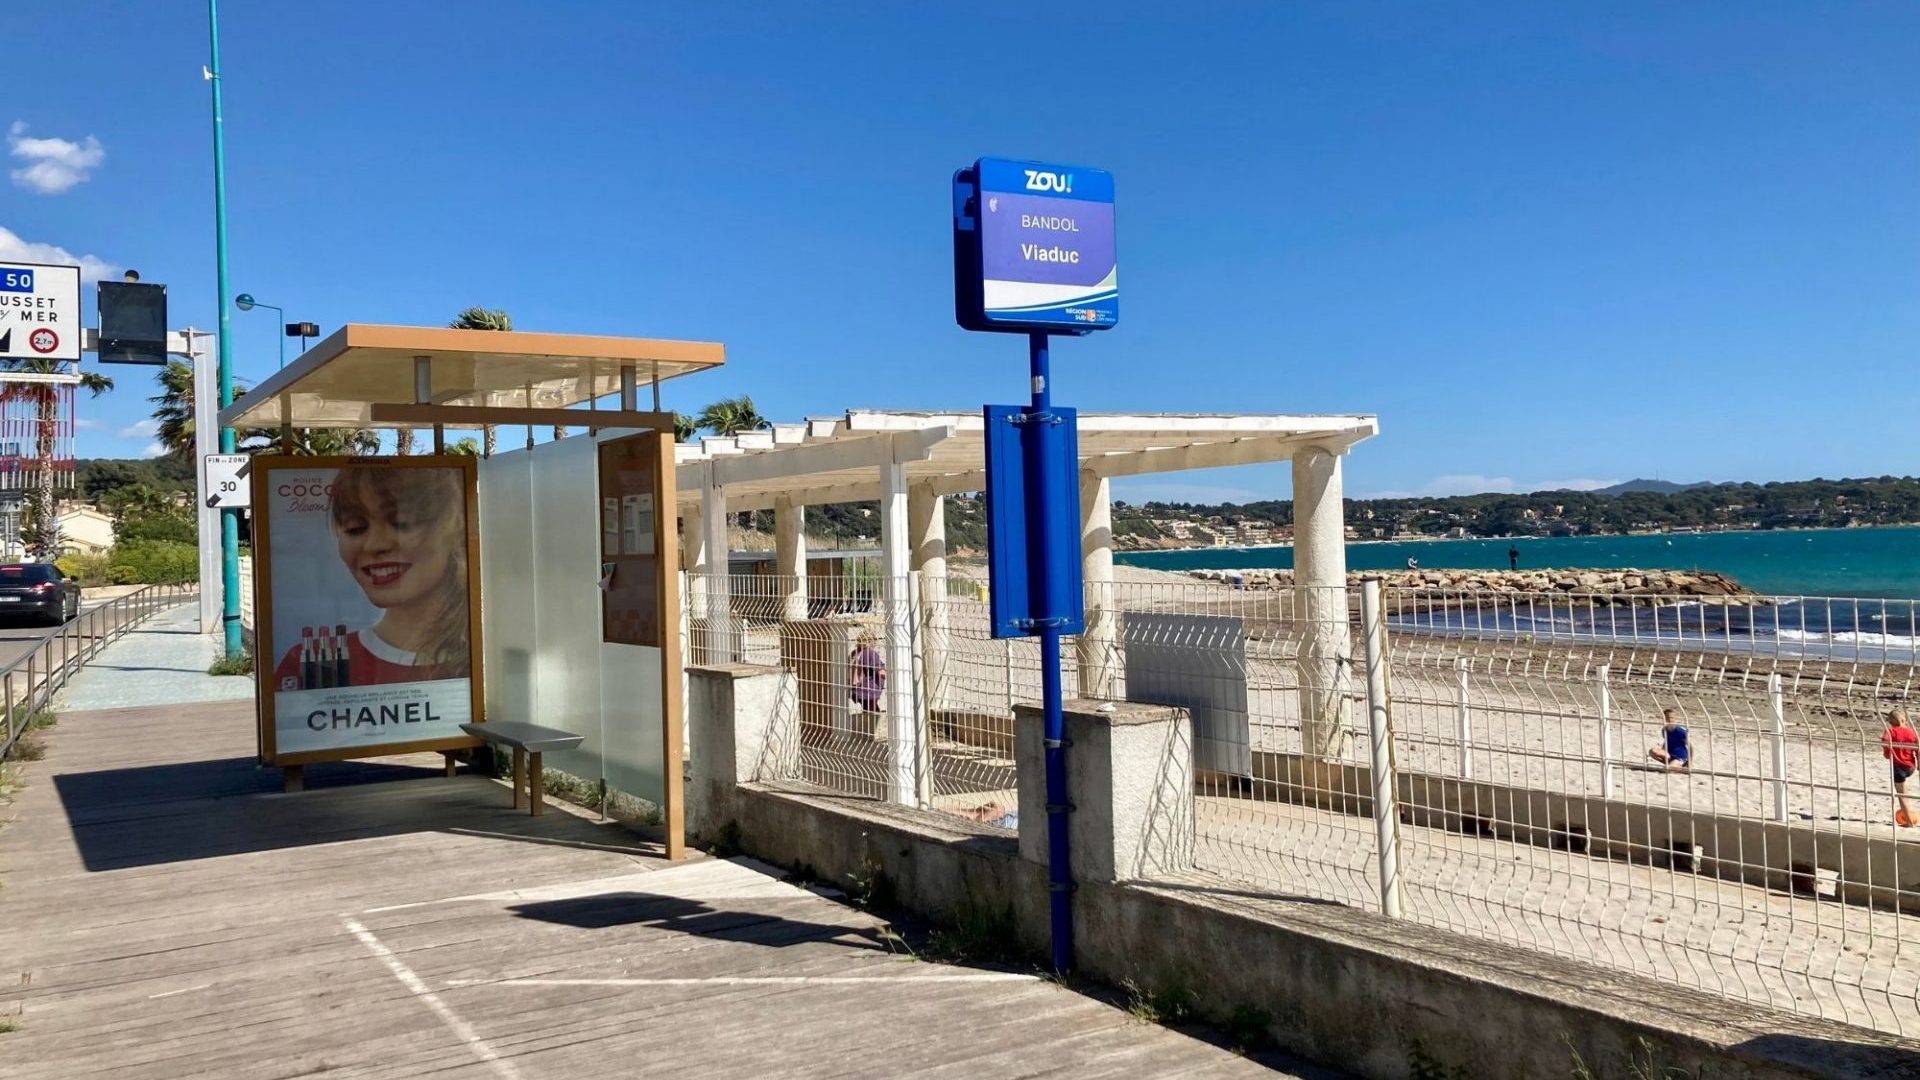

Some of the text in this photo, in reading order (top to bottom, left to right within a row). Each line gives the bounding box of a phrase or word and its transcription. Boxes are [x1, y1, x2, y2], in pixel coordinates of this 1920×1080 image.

[1024, 170, 1072, 193] ZOU!
[1021, 215, 1079, 232] BANDOL
[1021, 244, 1079, 263] Viaduc
[6, 273, 31, 288] 50
[0, 296, 56, 308] USSET
[21, 310, 57, 322] MER
[220, 481, 237, 492] 30
[278, 484, 338, 497] COCO
[307, 701, 441, 731] CHANEL
